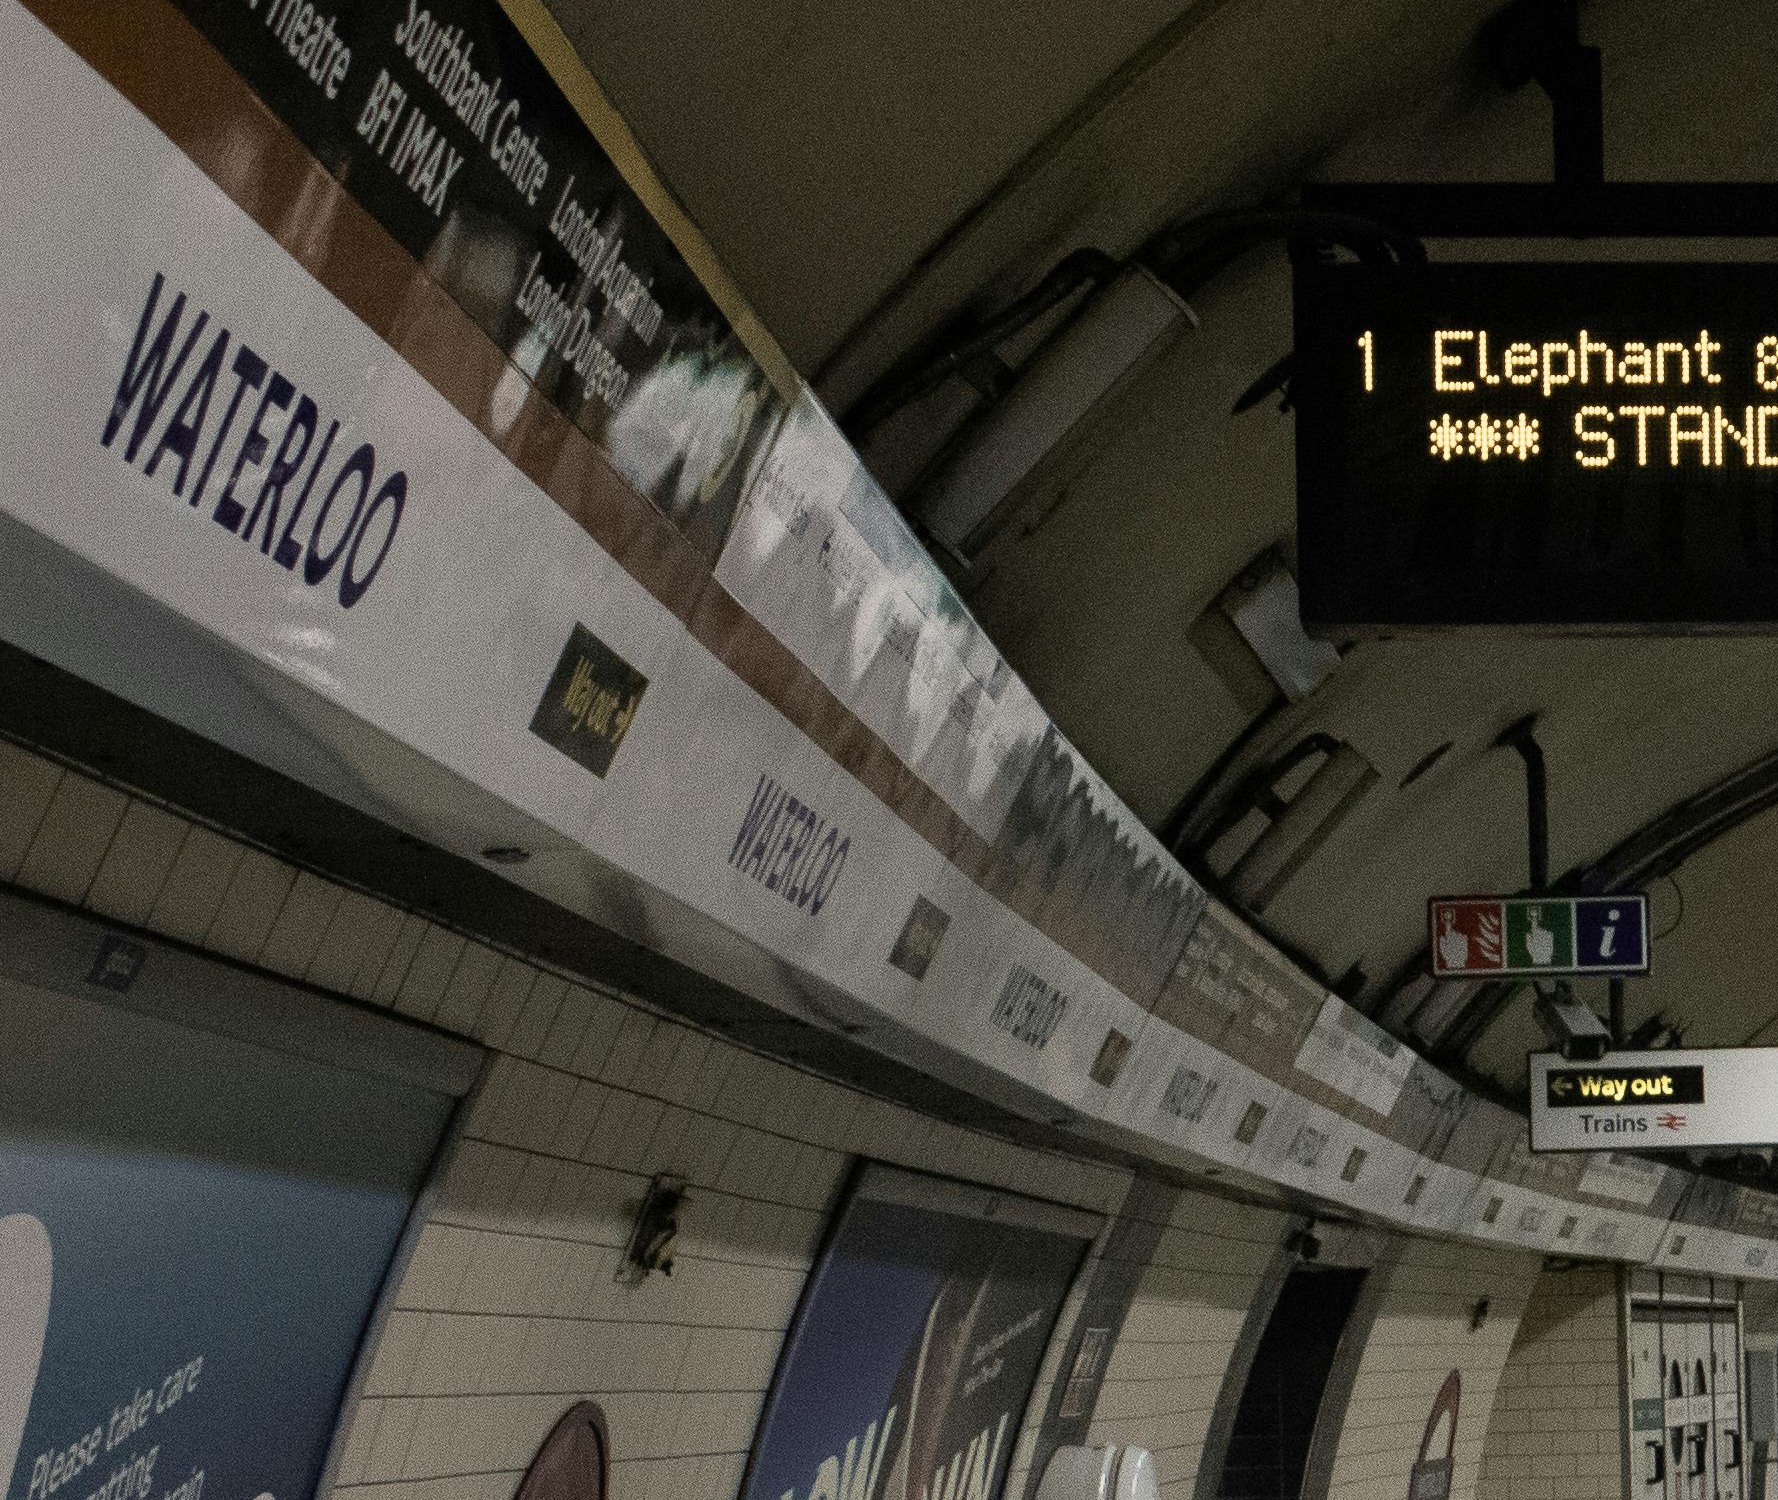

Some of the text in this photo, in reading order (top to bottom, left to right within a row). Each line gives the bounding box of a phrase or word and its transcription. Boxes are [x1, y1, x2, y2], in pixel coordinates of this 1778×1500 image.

[357, 68, 464, 216] BFI IMAX
[490, 99, 551, 206] Centre
[1358, 330, 1373, 392] 1
[1434, 330, 1722, 397] Elephant
[99, 272, 408, 610] WATERLOO
[728, 774, 851, 916] WATERLOO
[1578, 1074, 1673, 1102] Way out
[1580, 1113, 1647, 1134] Trains
[105, 1387, 154, 1451] take
[156, 1356, 203, 1416] care
